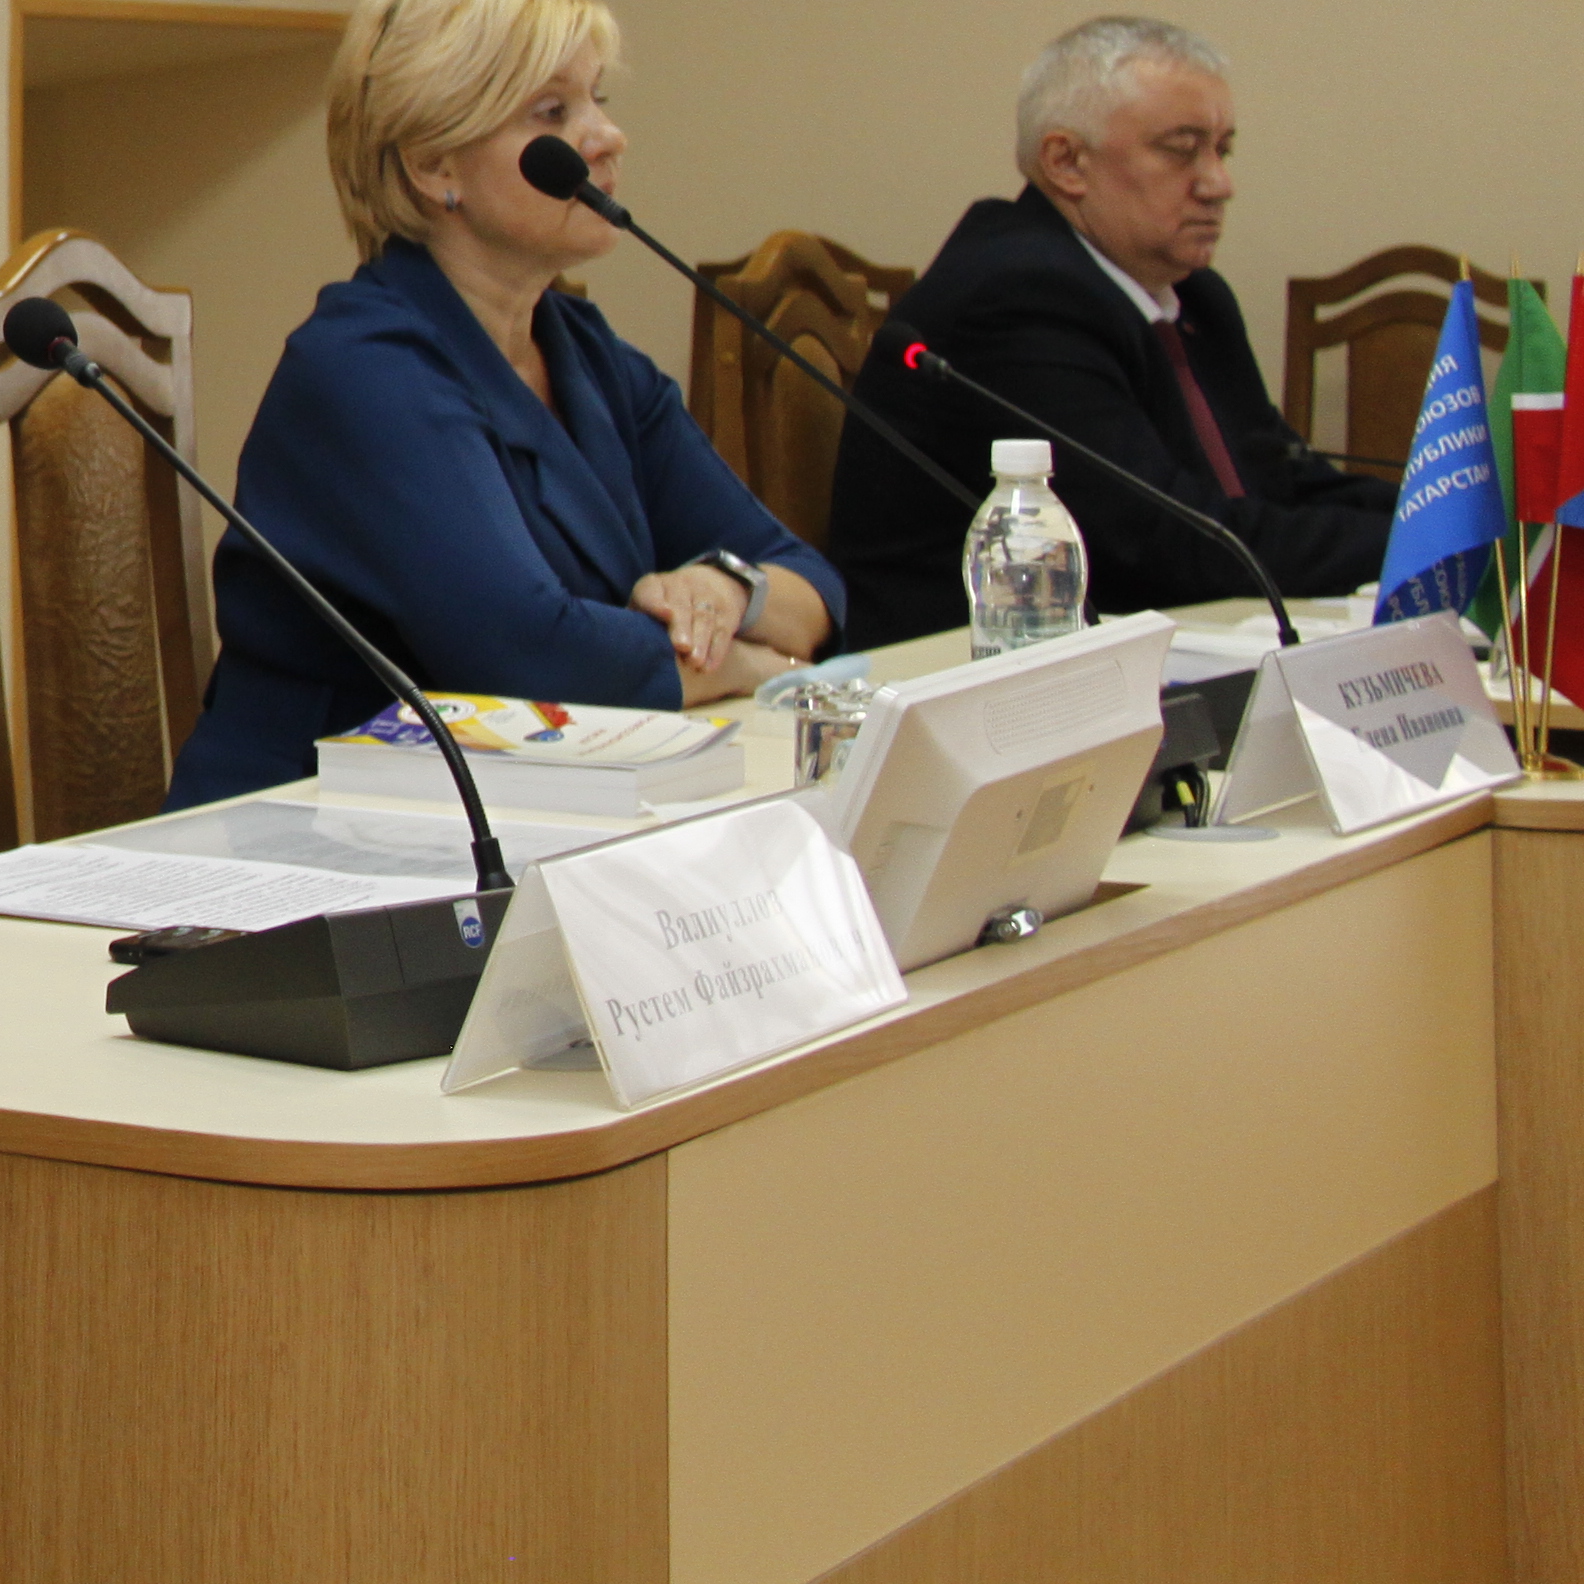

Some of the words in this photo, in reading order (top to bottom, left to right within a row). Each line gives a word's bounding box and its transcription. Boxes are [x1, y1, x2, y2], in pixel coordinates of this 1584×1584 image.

[1426, 354, 1459, 389] ИЯ
[1412, 385, 1482, 444] ОЮЗОВ
[1401, 424, 1487, 490] ПУБЛИКИ
[1338, 662, 1444, 709] КУЗЬМИЧЕВА
[606, 986, 693, 1041] Рустем
